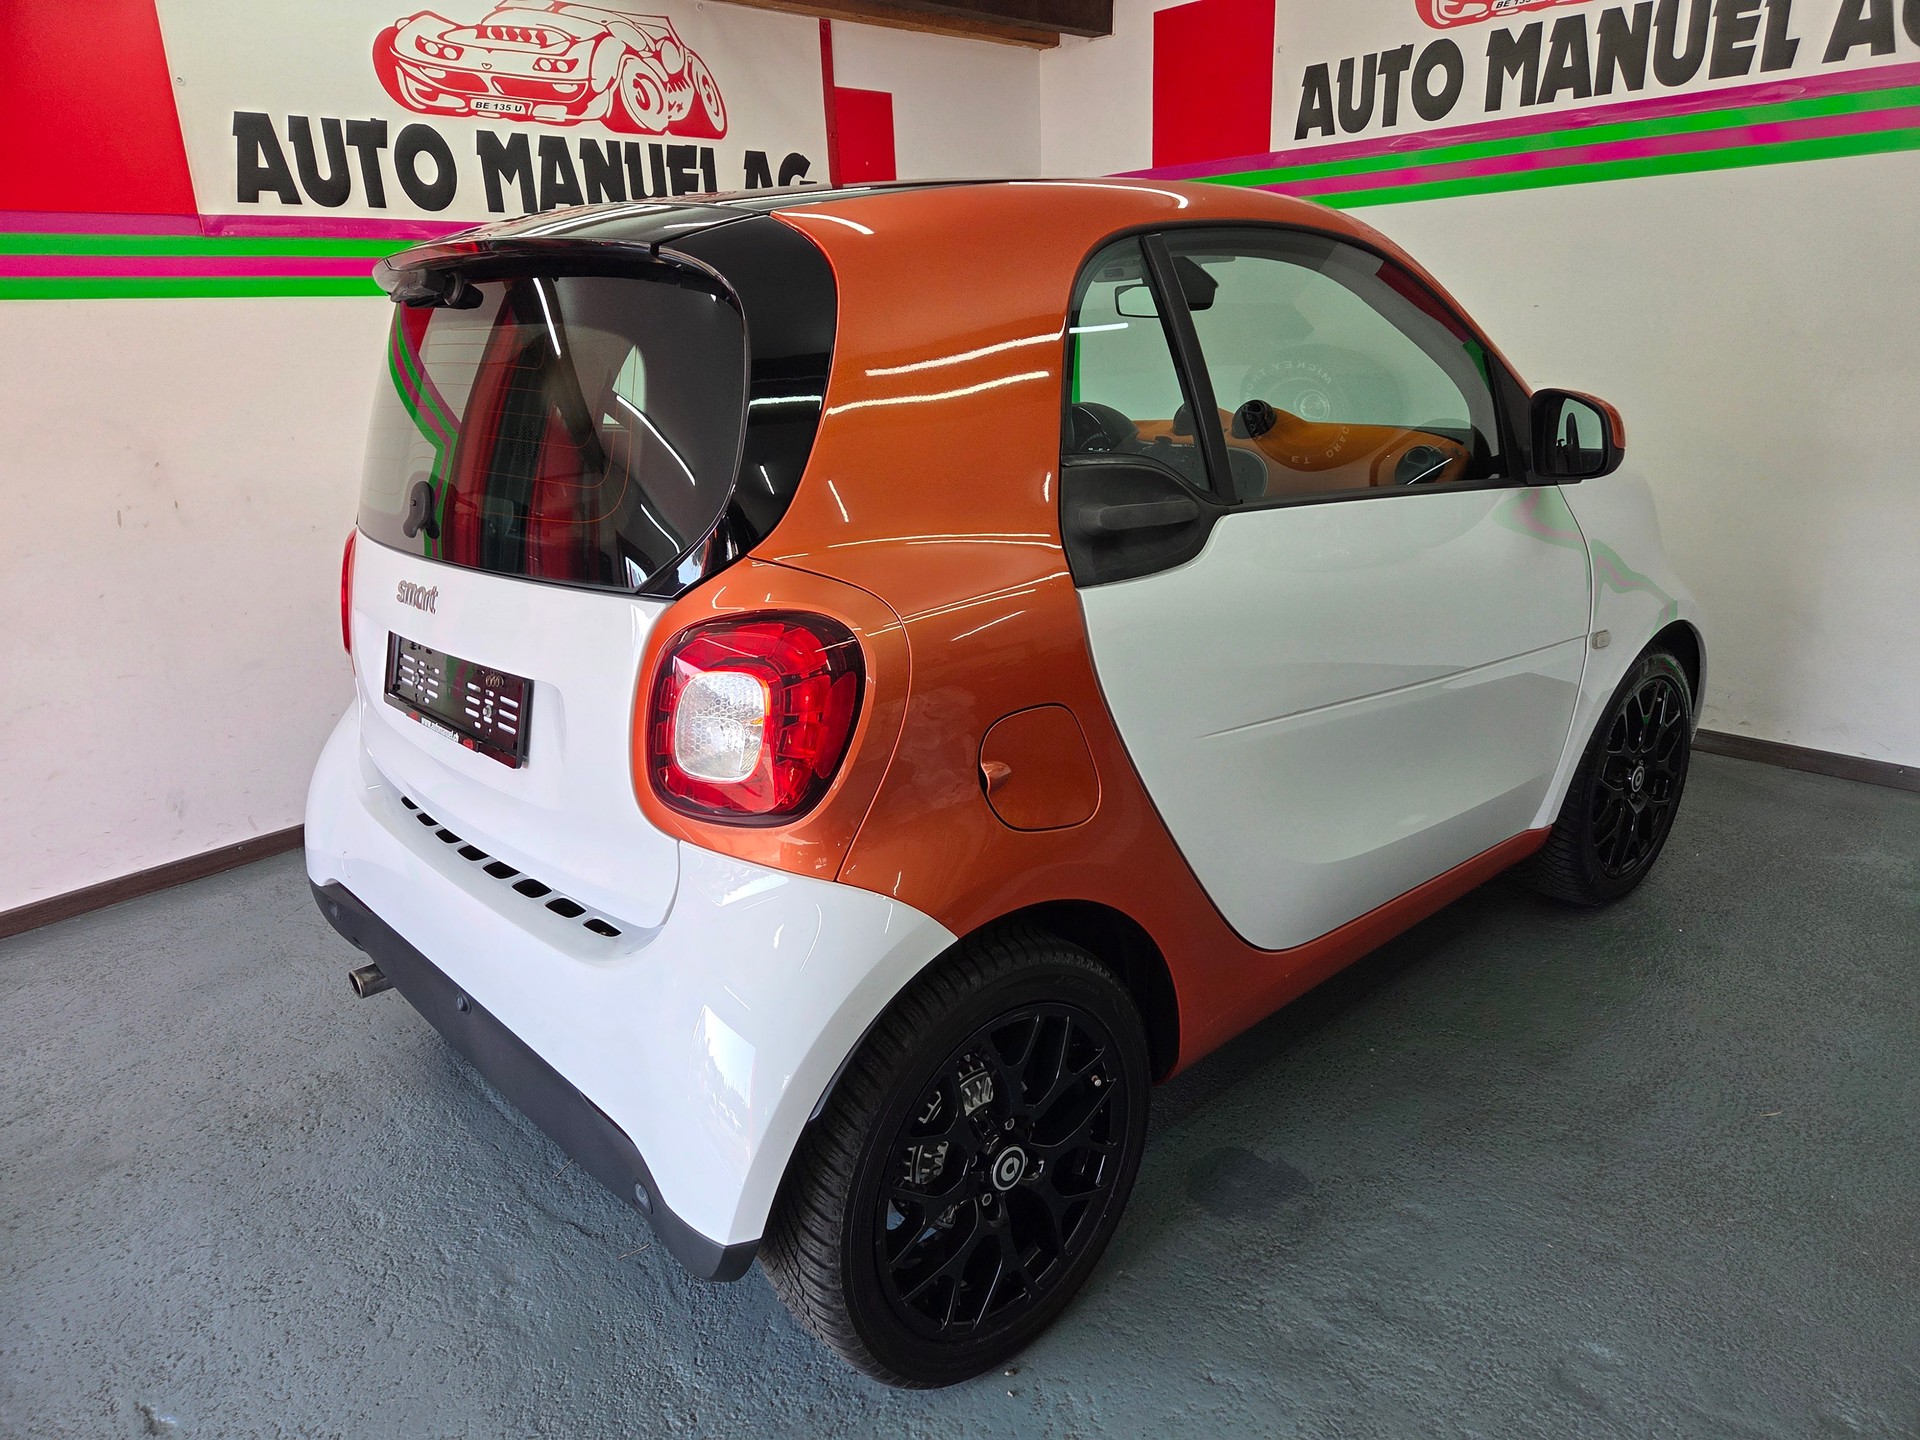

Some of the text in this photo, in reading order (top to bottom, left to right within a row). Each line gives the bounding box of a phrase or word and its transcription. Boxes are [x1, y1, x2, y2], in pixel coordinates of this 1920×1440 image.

[1294, 0, 1920, 141] AUTO MANUEL A
[233, 111, 457, 212] AUTO
[396, 580, 438, 614] smart
